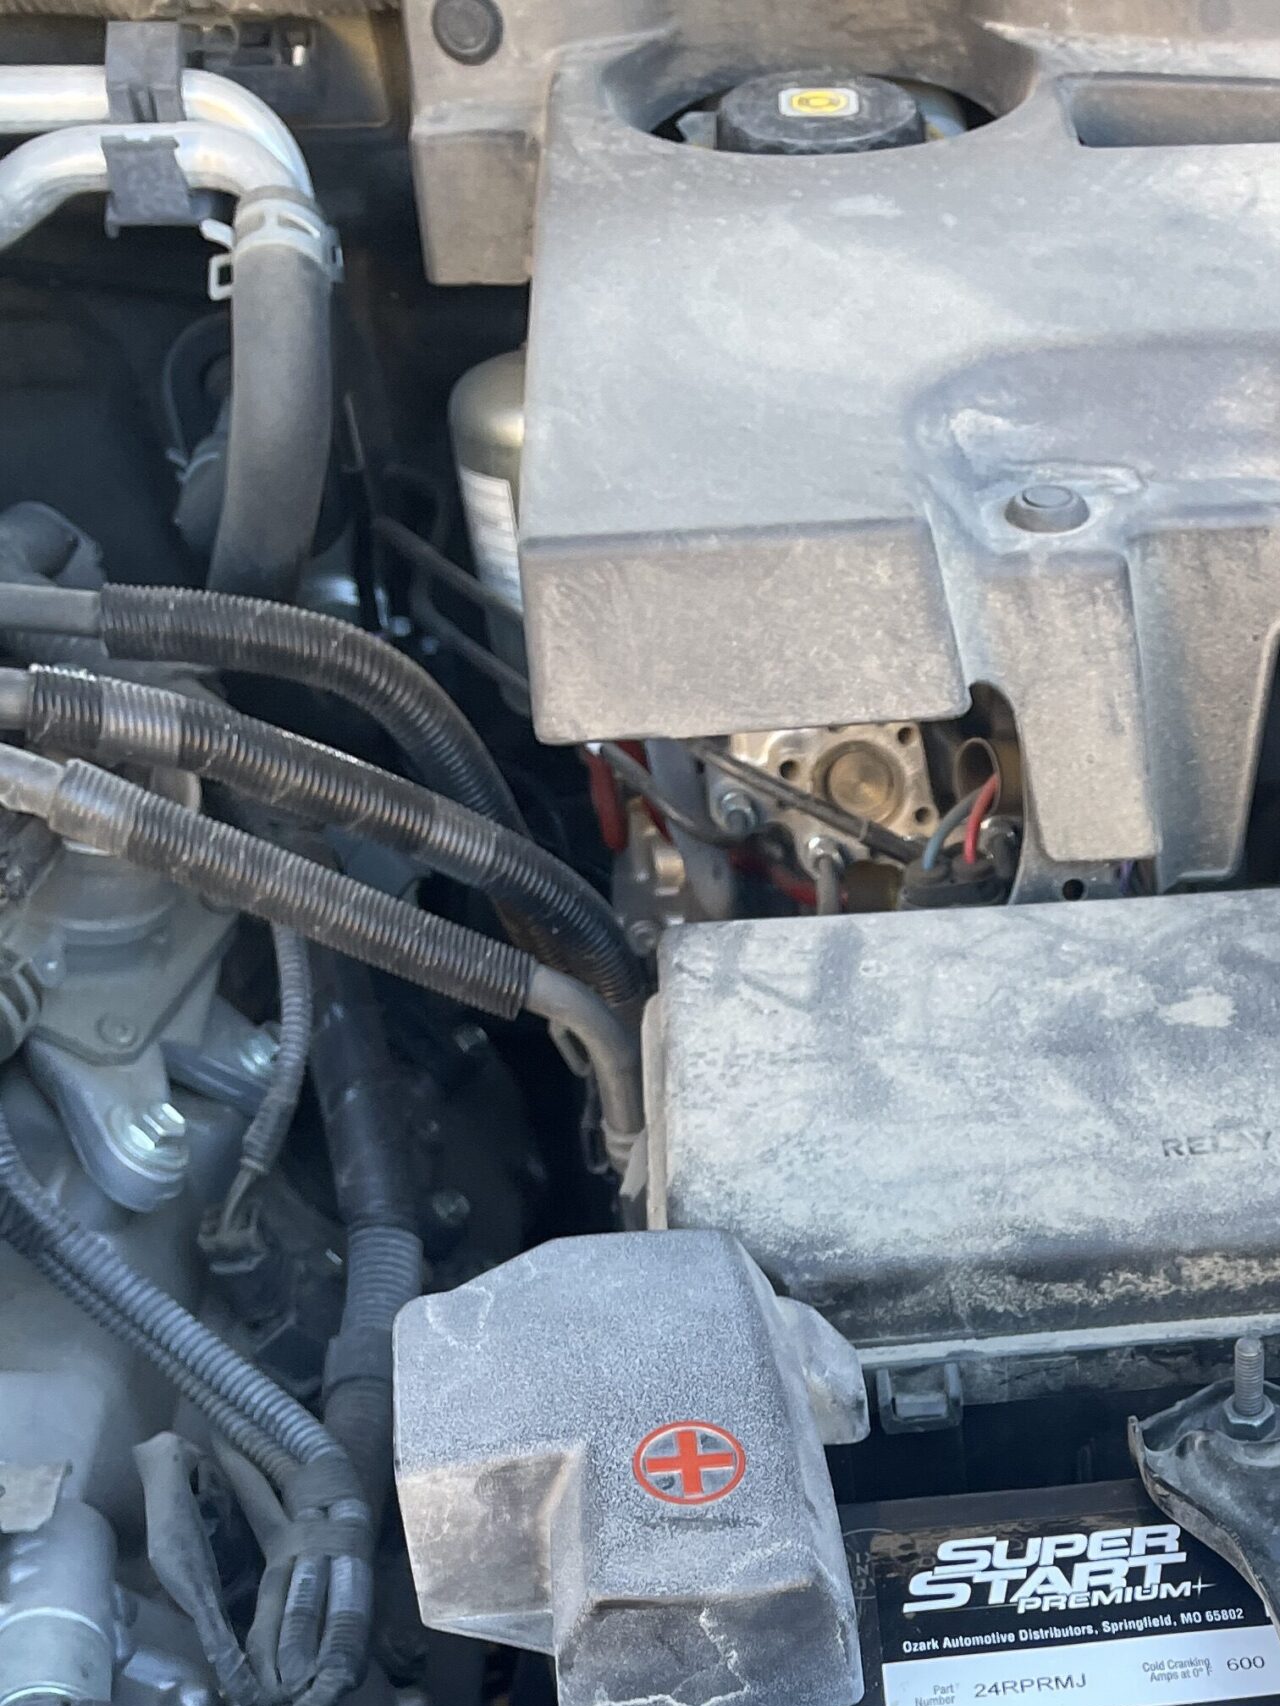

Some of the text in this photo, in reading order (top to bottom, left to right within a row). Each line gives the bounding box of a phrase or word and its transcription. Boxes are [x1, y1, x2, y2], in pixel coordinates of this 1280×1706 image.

[1161, 1130, 1272, 1157] RELY
[933, 1523, 1181, 1576] SUPER
[902, 1551, 1187, 1614] START
[903, 1608, 1244, 1654] Ozark Automotive Distributors, Springfield, MO 65802
[1142, 1657, 1211, 1673] Cold Cranking
[1150, 1669, 1179, 1683] Amps
[1181, 1668, 1191, 1679] at
[1226, 1655, 1265, 1672] 600
[933, 1682, 955, 1695] Part
[974, 1673, 1087, 1698] 24RPRMJ
